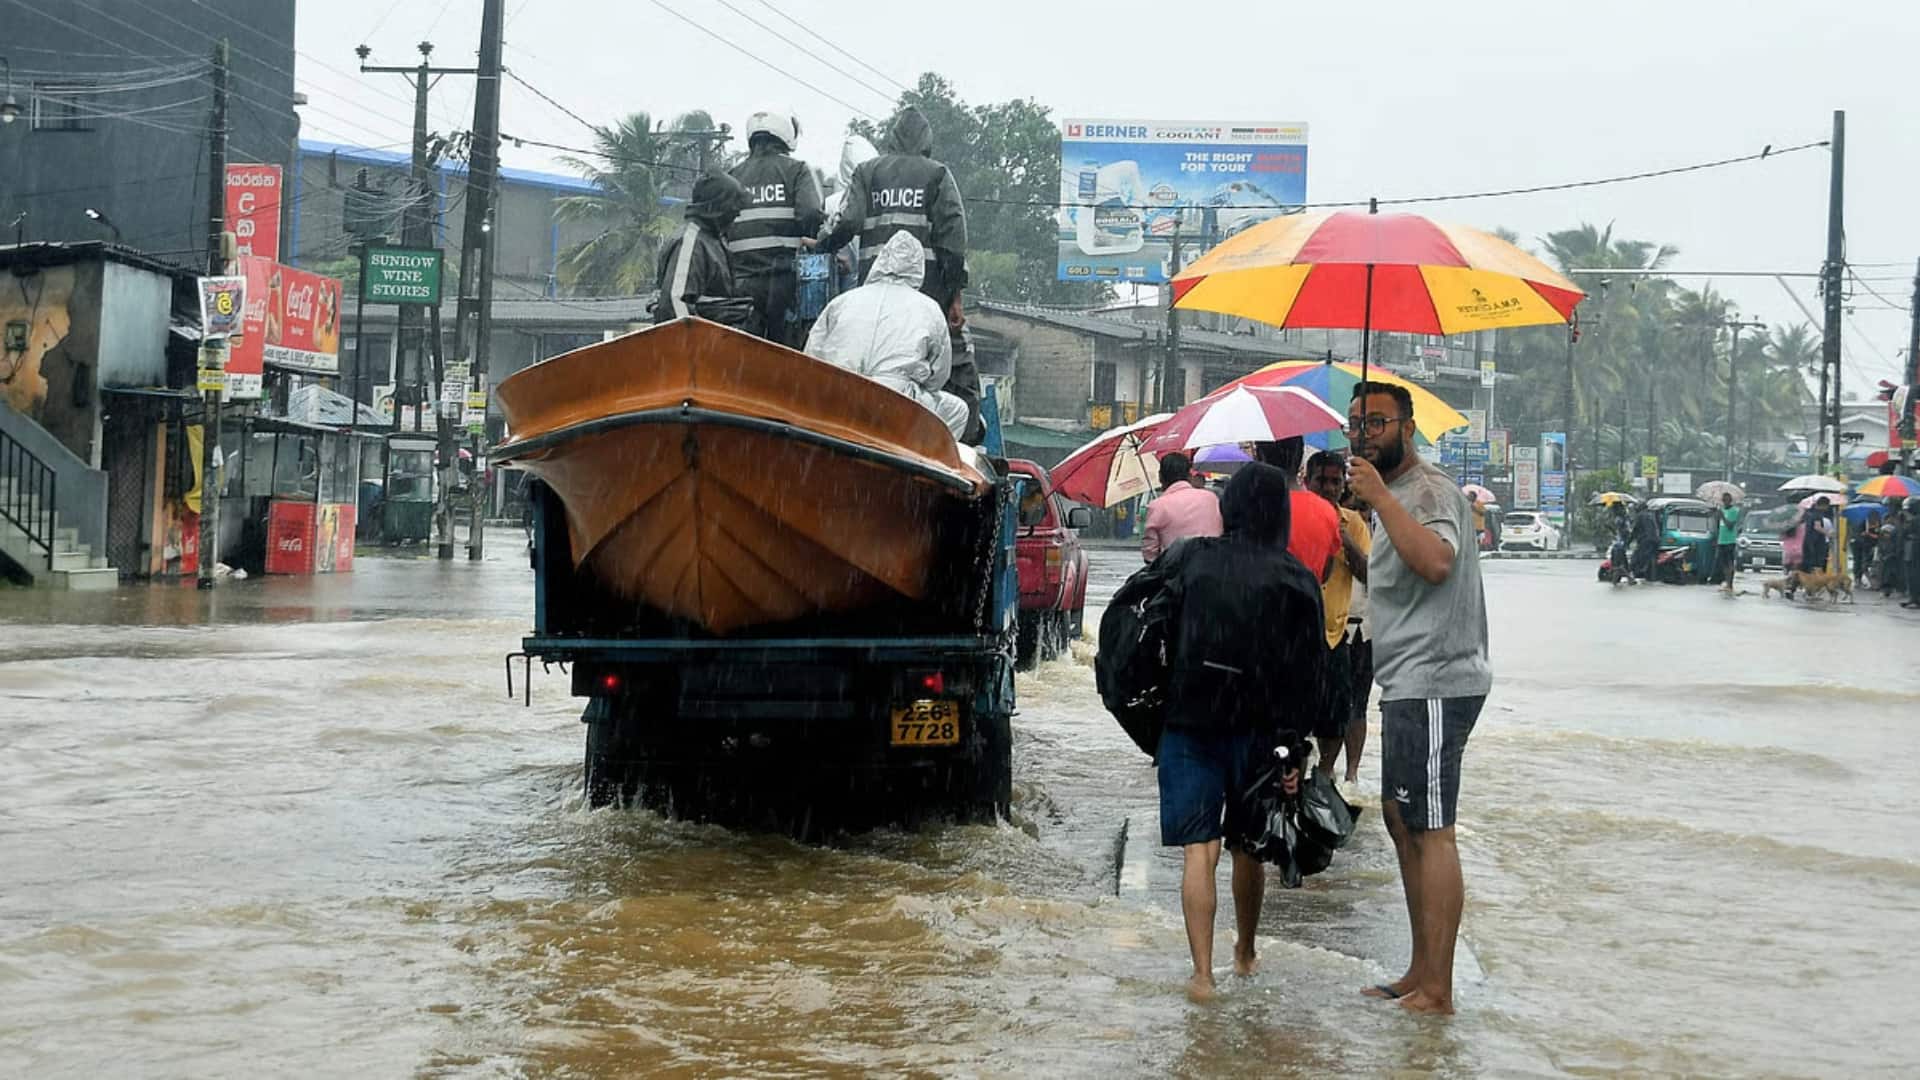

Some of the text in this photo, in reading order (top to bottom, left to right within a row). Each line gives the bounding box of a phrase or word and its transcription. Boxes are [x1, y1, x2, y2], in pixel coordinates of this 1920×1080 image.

[1085, 125, 1221, 139] BERNER COOLANT
[1186, 152, 1209, 163] THE
[1212, 152, 1253, 163] RIGHT
[1180, 162, 1206, 172] FOR
[1209, 162, 1247, 173] YOUR
[745, 184, 786, 204] LICE
[871, 188, 925, 208] POLICE
[371, 254, 435, 269] SUNROW
[382, 270, 423, 282] WINE
[372, 284, 431, 297] STORES
[896, 722, 954, 740] 7728
